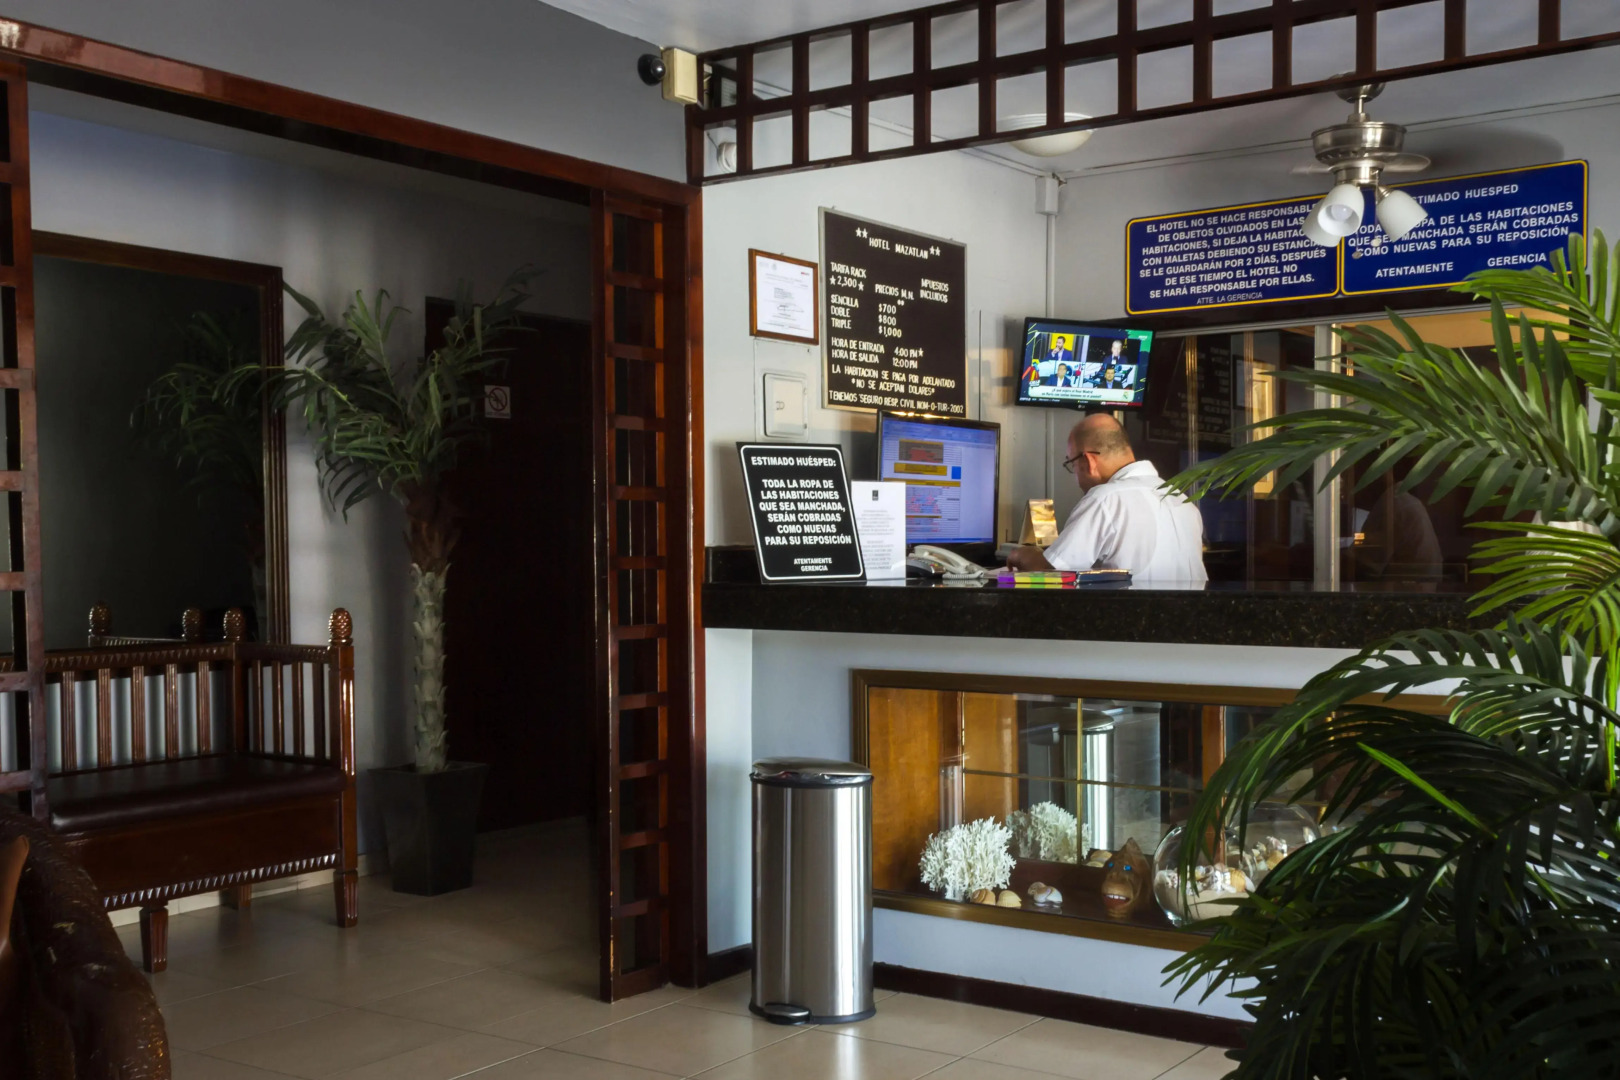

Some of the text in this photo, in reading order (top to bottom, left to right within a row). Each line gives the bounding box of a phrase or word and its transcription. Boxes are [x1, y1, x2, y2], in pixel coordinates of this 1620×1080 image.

[1412, 183, 1519, 204] TIMADO HUESPED
[1146, 224, 1158, 233] EL
[1159, 220, 1189, 231] HOTEL
[1191, 218, 1205, 228] NO
[1206, 216, 1219, 226] SE
[1220, 212, 1246, 224] HACE
[1355, 223, 1382, 235] ODA
[1440, 214, 1455, 226] DE
[1460, 211, 1482, 223] LAS
[1487, 201, 1574, 220] HABITACIONES
[1158, 216, 1305, 243] DE OBJETOS OLVIDADOS EN LAS
[1348, 236, 1371, 247] QUE
[1401, 226, 1464, 241] MANCHADA
[1468, 220, 1508, 234] SERÁN
[1512, 213, 1579, 229] COBRADAS
[1393, 240, 1437, 253] NUEVAS
[1441, 236, 1472, 249] PARA
[1476, 234, 1492, 245] SU
[1497, 225, 1569, 243] REPOSICIÓN
[869, 237, 929, 260] HOTEL MAZATLAN
[1142, 229, 1305, 256] HABITACIONES, SI DEJA LA HABITAC
[1139, 248, 1326, 278] SE LE GUARDARÁN POR 2 DÍAS, DESPUÉS
[1142, 257, 1162, 267] CON
[1164, 251, 1205, 264] MALETAS
[1207, 246, 1255, 259] DEBIENDO
[1257, 243, 1271, 254] SU
[1375, 252, 1547, 278] ATENTAMENTE GERENCIA
[830, 261, 867, 279] TARIFA RACK
[1165, 263, 1298, 286] DE ESE TIEMPO EL HOTEL NO
[875, 283, 899, 297] PRECIOS
[1149, 273, 1315, 299] SE HARÁ RESPONSABLE POR ELLAS.
[830, 294, 897, 315] SENCILLA $700
[920, 289, 948, 304] INCLUIDOS
[1217, 295, 1226, 303] LA
[1227, 291, 1263, 302] GERENCIA
[830, 305, 897, 326] DOBLE $800
[831, 317, 902, 338] TRIPLE $1,000
[831, 336, 849, 349] HORA
[849, 339, 858, 350] DE
[858, 340, 885, 354] ENTRADA
[831, 349, 849, 360] HORA
[849, 351, 858, 361] DE
[858, 352, 880, 364] SALIDA
[831, 363, 955, 389] LA HABITACION SE PAGA POR ADELANTADO
[868, 379, 876, 390] SE
[879, 381, 905, 393] ACEPTAN
[829, 389, 858, 402] TENEMOS
[900, 398, 916, 409] CIVIL
[751, 455, 837, 467] ESTIMADO HUÉSPED:
[762, 479, 834, 489] TODA LA ROPA DE
[760, 490, 840, 500] LAS HABITACIONES
[759, 501, 846, 512] QUE SEA MANCHADA,
[767, 511, 841, 523] SERÁN COBRADAS
[777, 524, 837, 534] COMO NUEVAS
[764, 533, 852, 546] PARA SU REPOSICIÓN
[793, 557, 832, 565] ATENTAMENTE
[800, 564, 828, 572] GERENCIA
